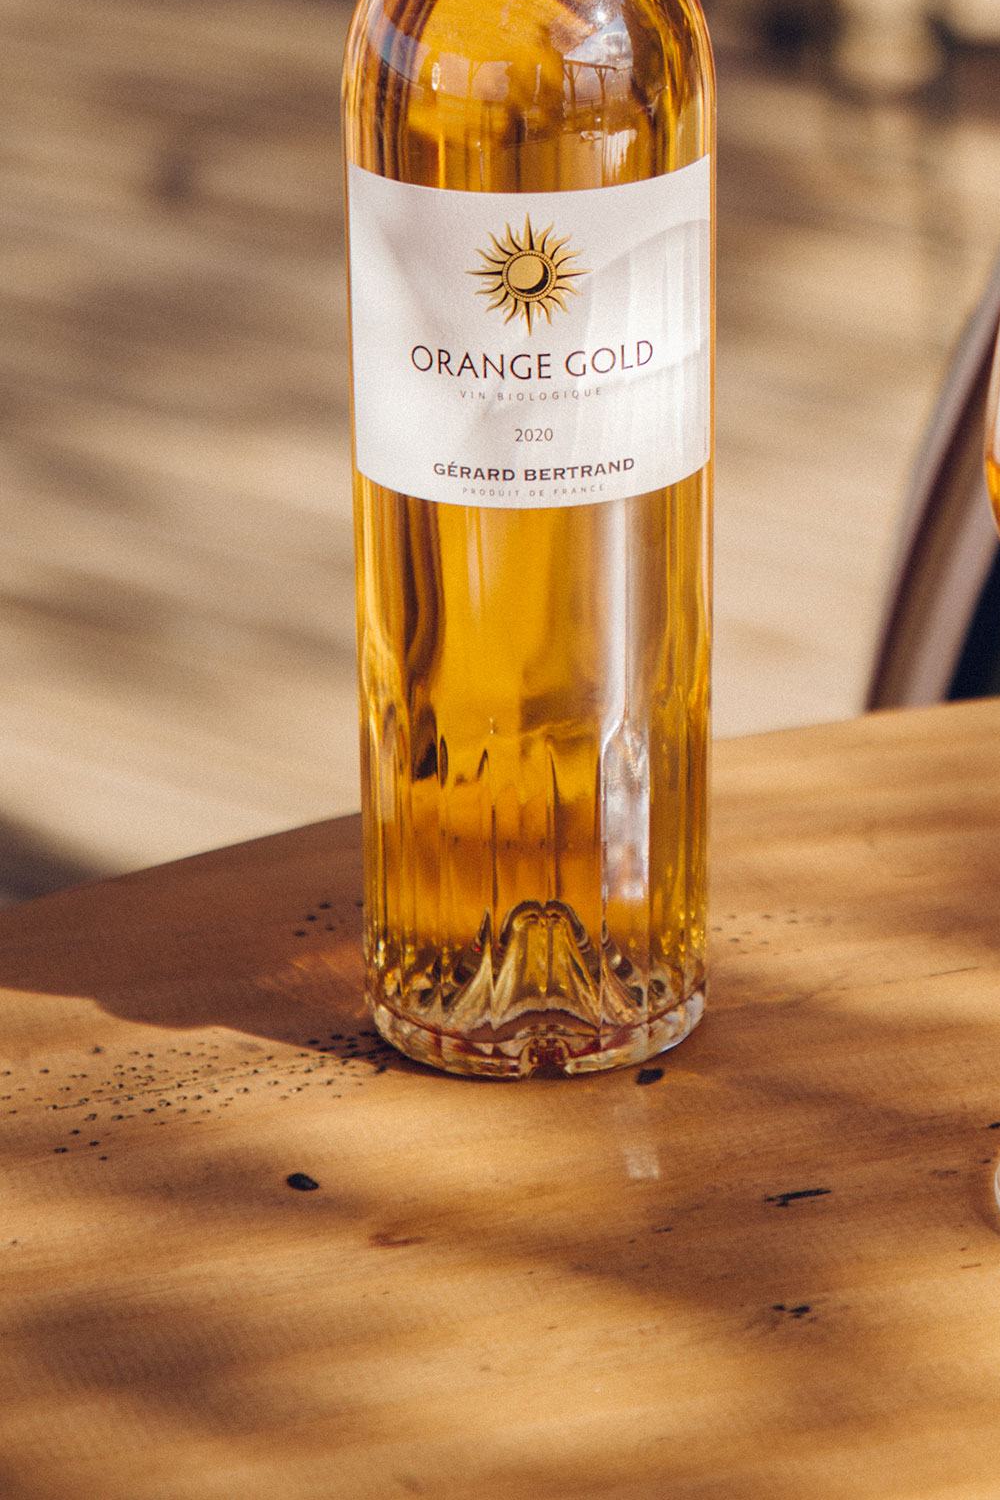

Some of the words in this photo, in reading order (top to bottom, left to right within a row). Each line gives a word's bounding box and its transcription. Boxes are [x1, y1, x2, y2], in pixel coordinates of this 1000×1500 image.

[411, 345, 552, 381] ORANGE
[565, 340, 653, 377] GOLD
[460, 390, 486, 400] VIN
[497, 387, 603, 402] BIOLOGIQUE
[514, 428, 554, 442] 2020
[433, 461, 516, 482] GÉRARD
[524, 458, 635, 482] BERTRAND
[462, 487, 520, 498] PRODUIT
[529, 489, 545, 497] DE
[553, 484, 605, 497] FRANCE
